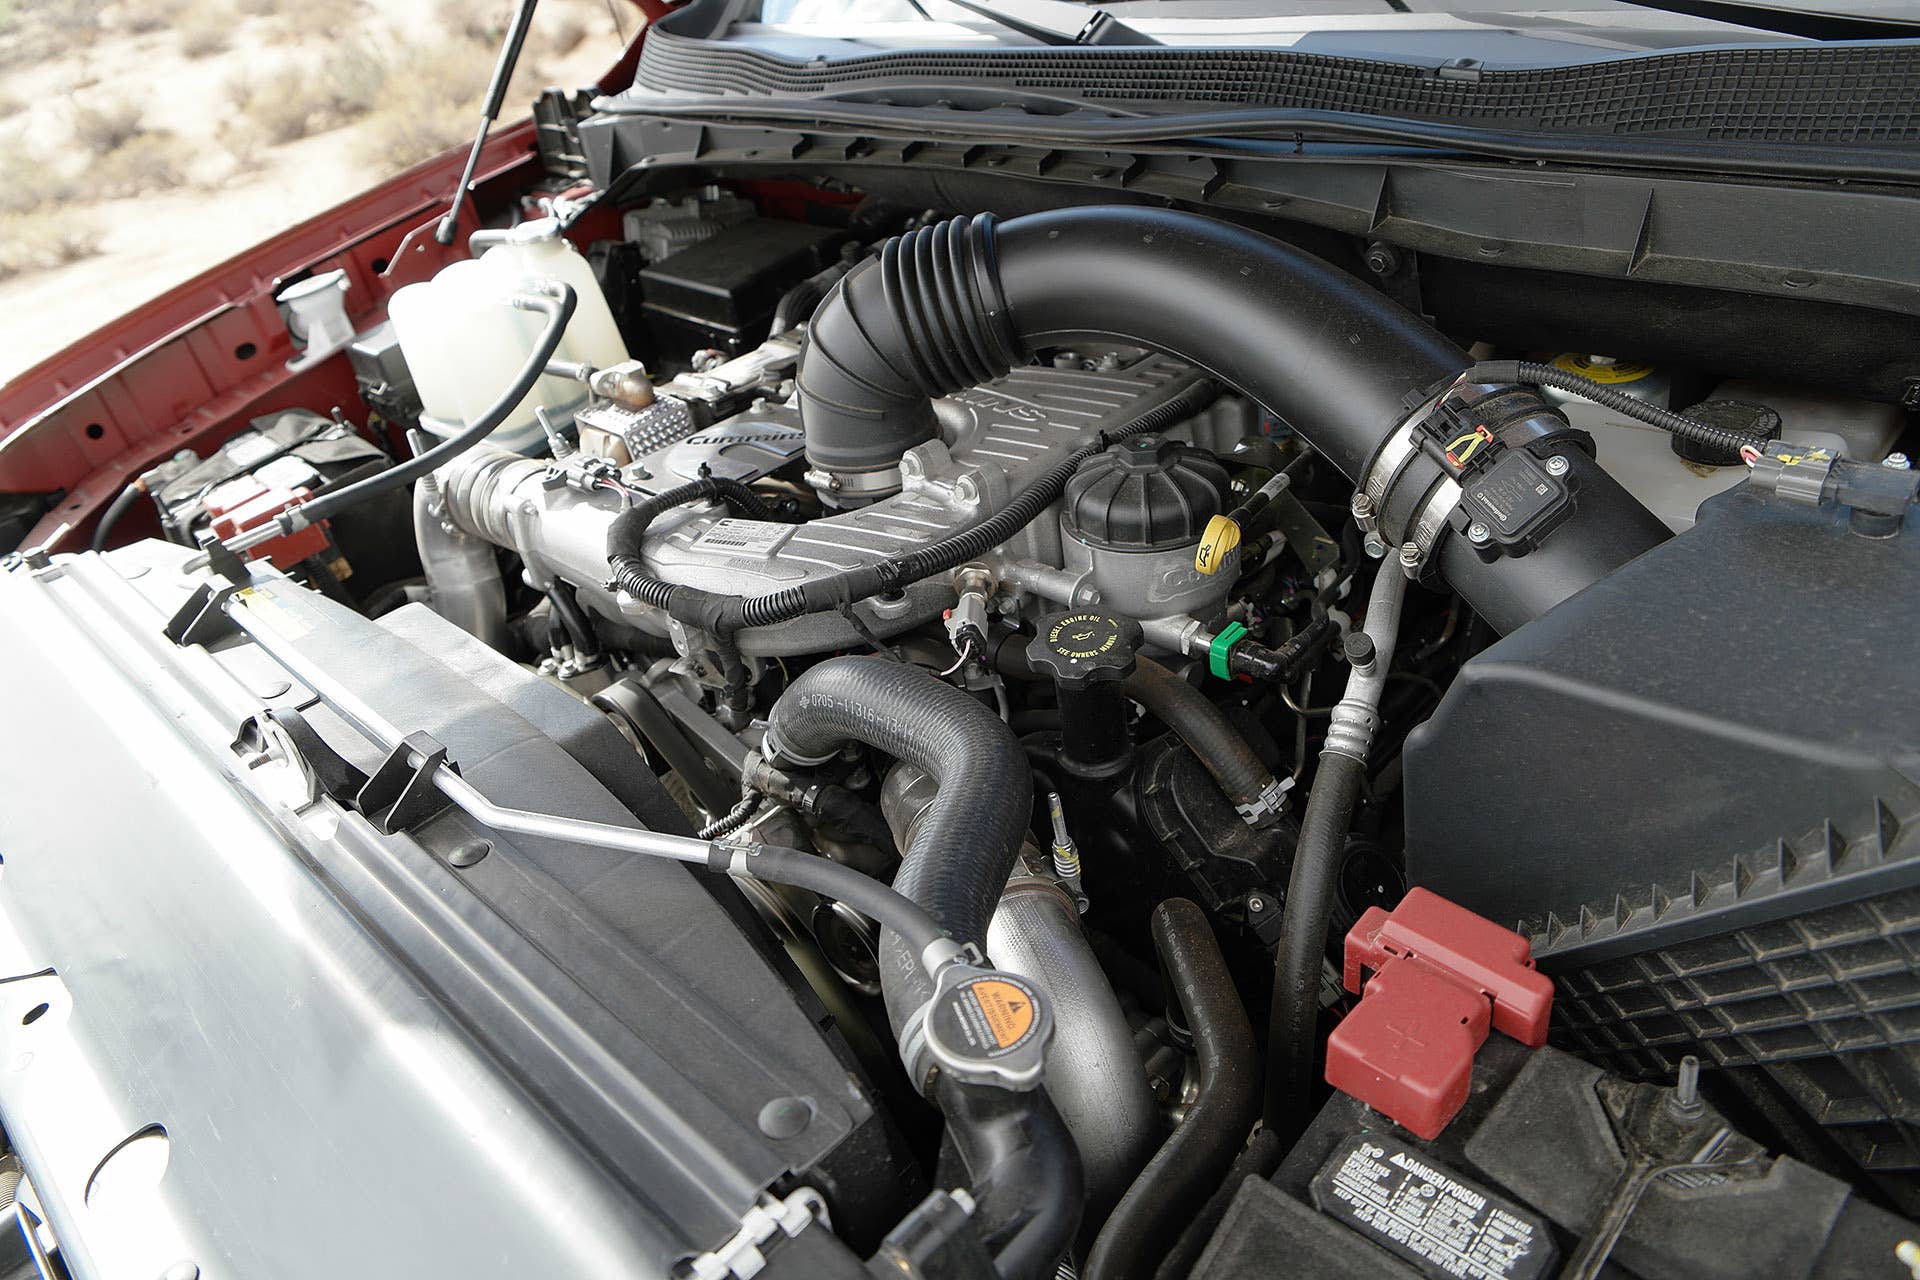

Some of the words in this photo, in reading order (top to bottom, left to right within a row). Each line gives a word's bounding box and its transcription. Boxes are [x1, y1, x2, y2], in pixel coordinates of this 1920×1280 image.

[1049, 625, 1064, 643] DIESEL
[1060, 614, 1088, 627] ENGINE
[1089, 615, 1101, 623] OIL
[1056, 647, 1071, 657] SEE
[1070, 649, 1099, 658] OWNERS
[1099, 633, 1118, 653] MANUAL
